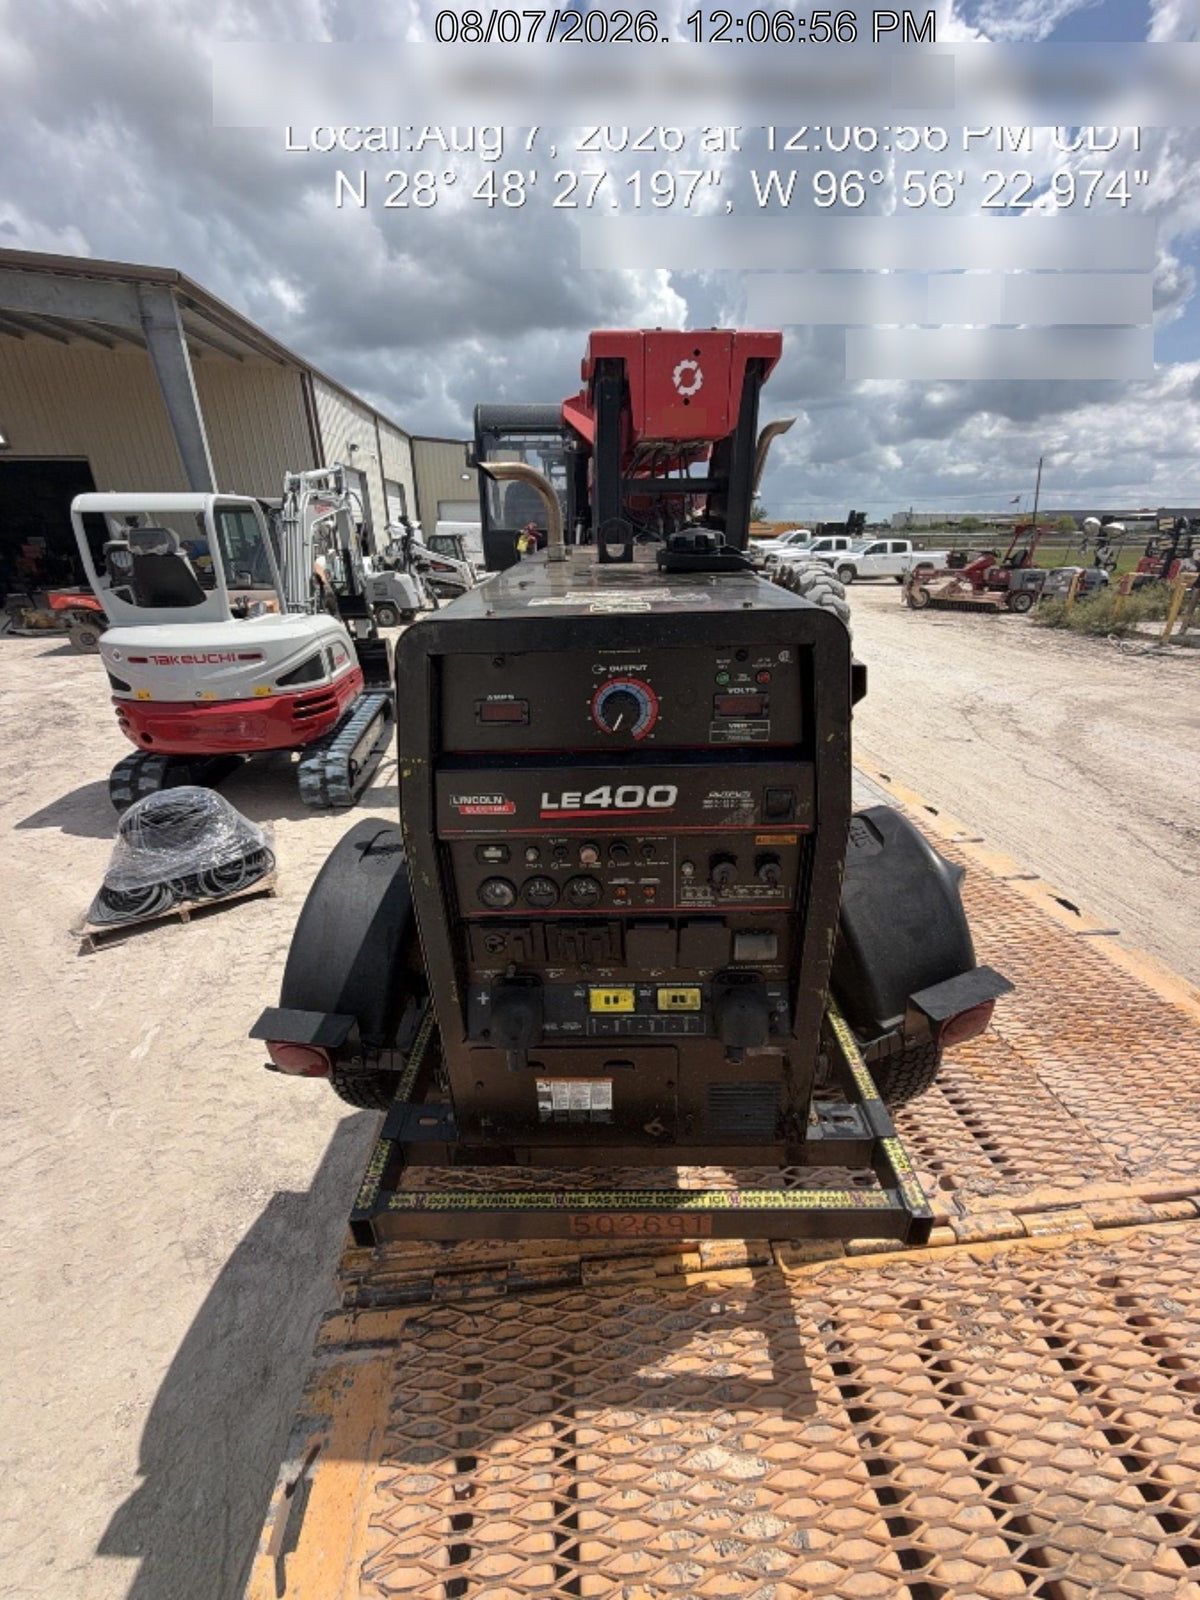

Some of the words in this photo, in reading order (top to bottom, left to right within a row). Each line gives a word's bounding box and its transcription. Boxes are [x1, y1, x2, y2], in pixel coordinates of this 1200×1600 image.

[148, 652, 236, 666] TAKEUCHI
[452, 796, 503, 805] LINCOLN
[541, 785, 678, 809] LE400
[573, 1214, 704, 1236] 502691
